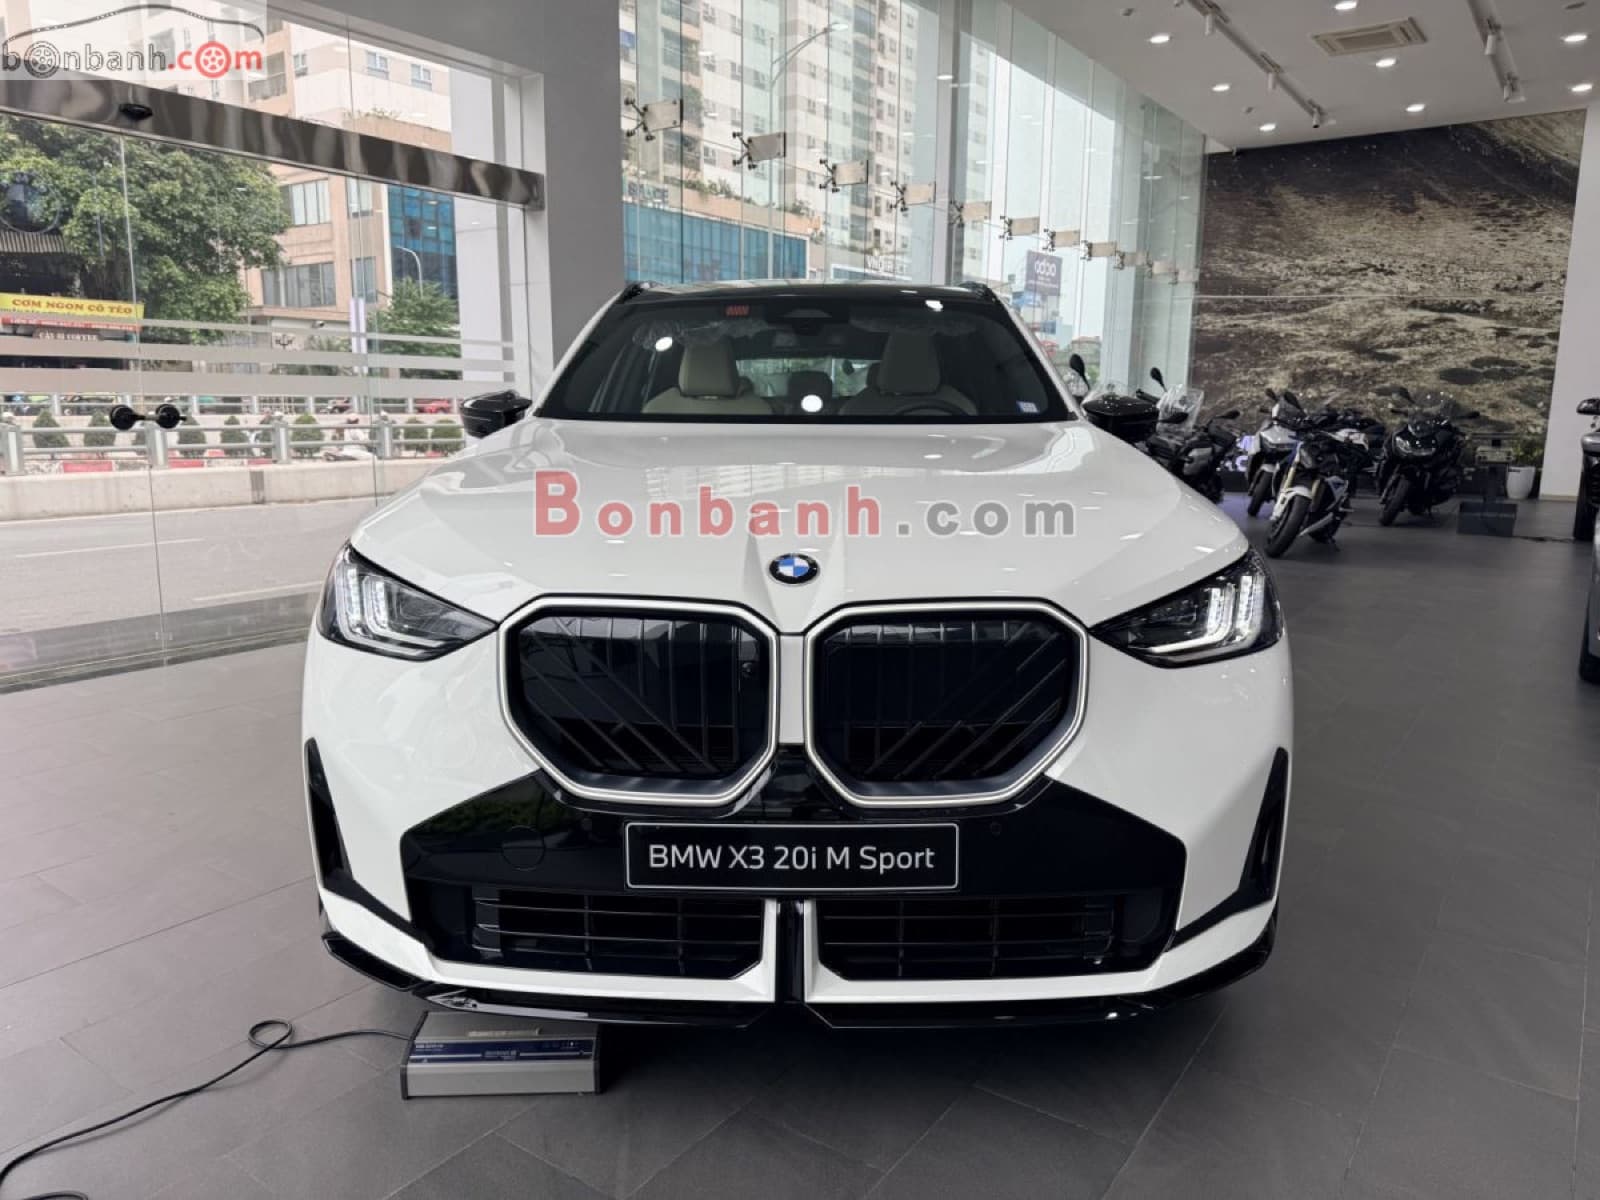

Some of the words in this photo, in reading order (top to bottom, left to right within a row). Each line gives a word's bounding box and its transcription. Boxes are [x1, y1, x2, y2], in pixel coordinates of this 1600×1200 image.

[649, 844, 722, 868] BMW
[728, 845, 765, 869] X3
[773, 846, 817, 870] 20i
[827, 846, 850, 869] M
[859, 845, 935, 874] Sport
